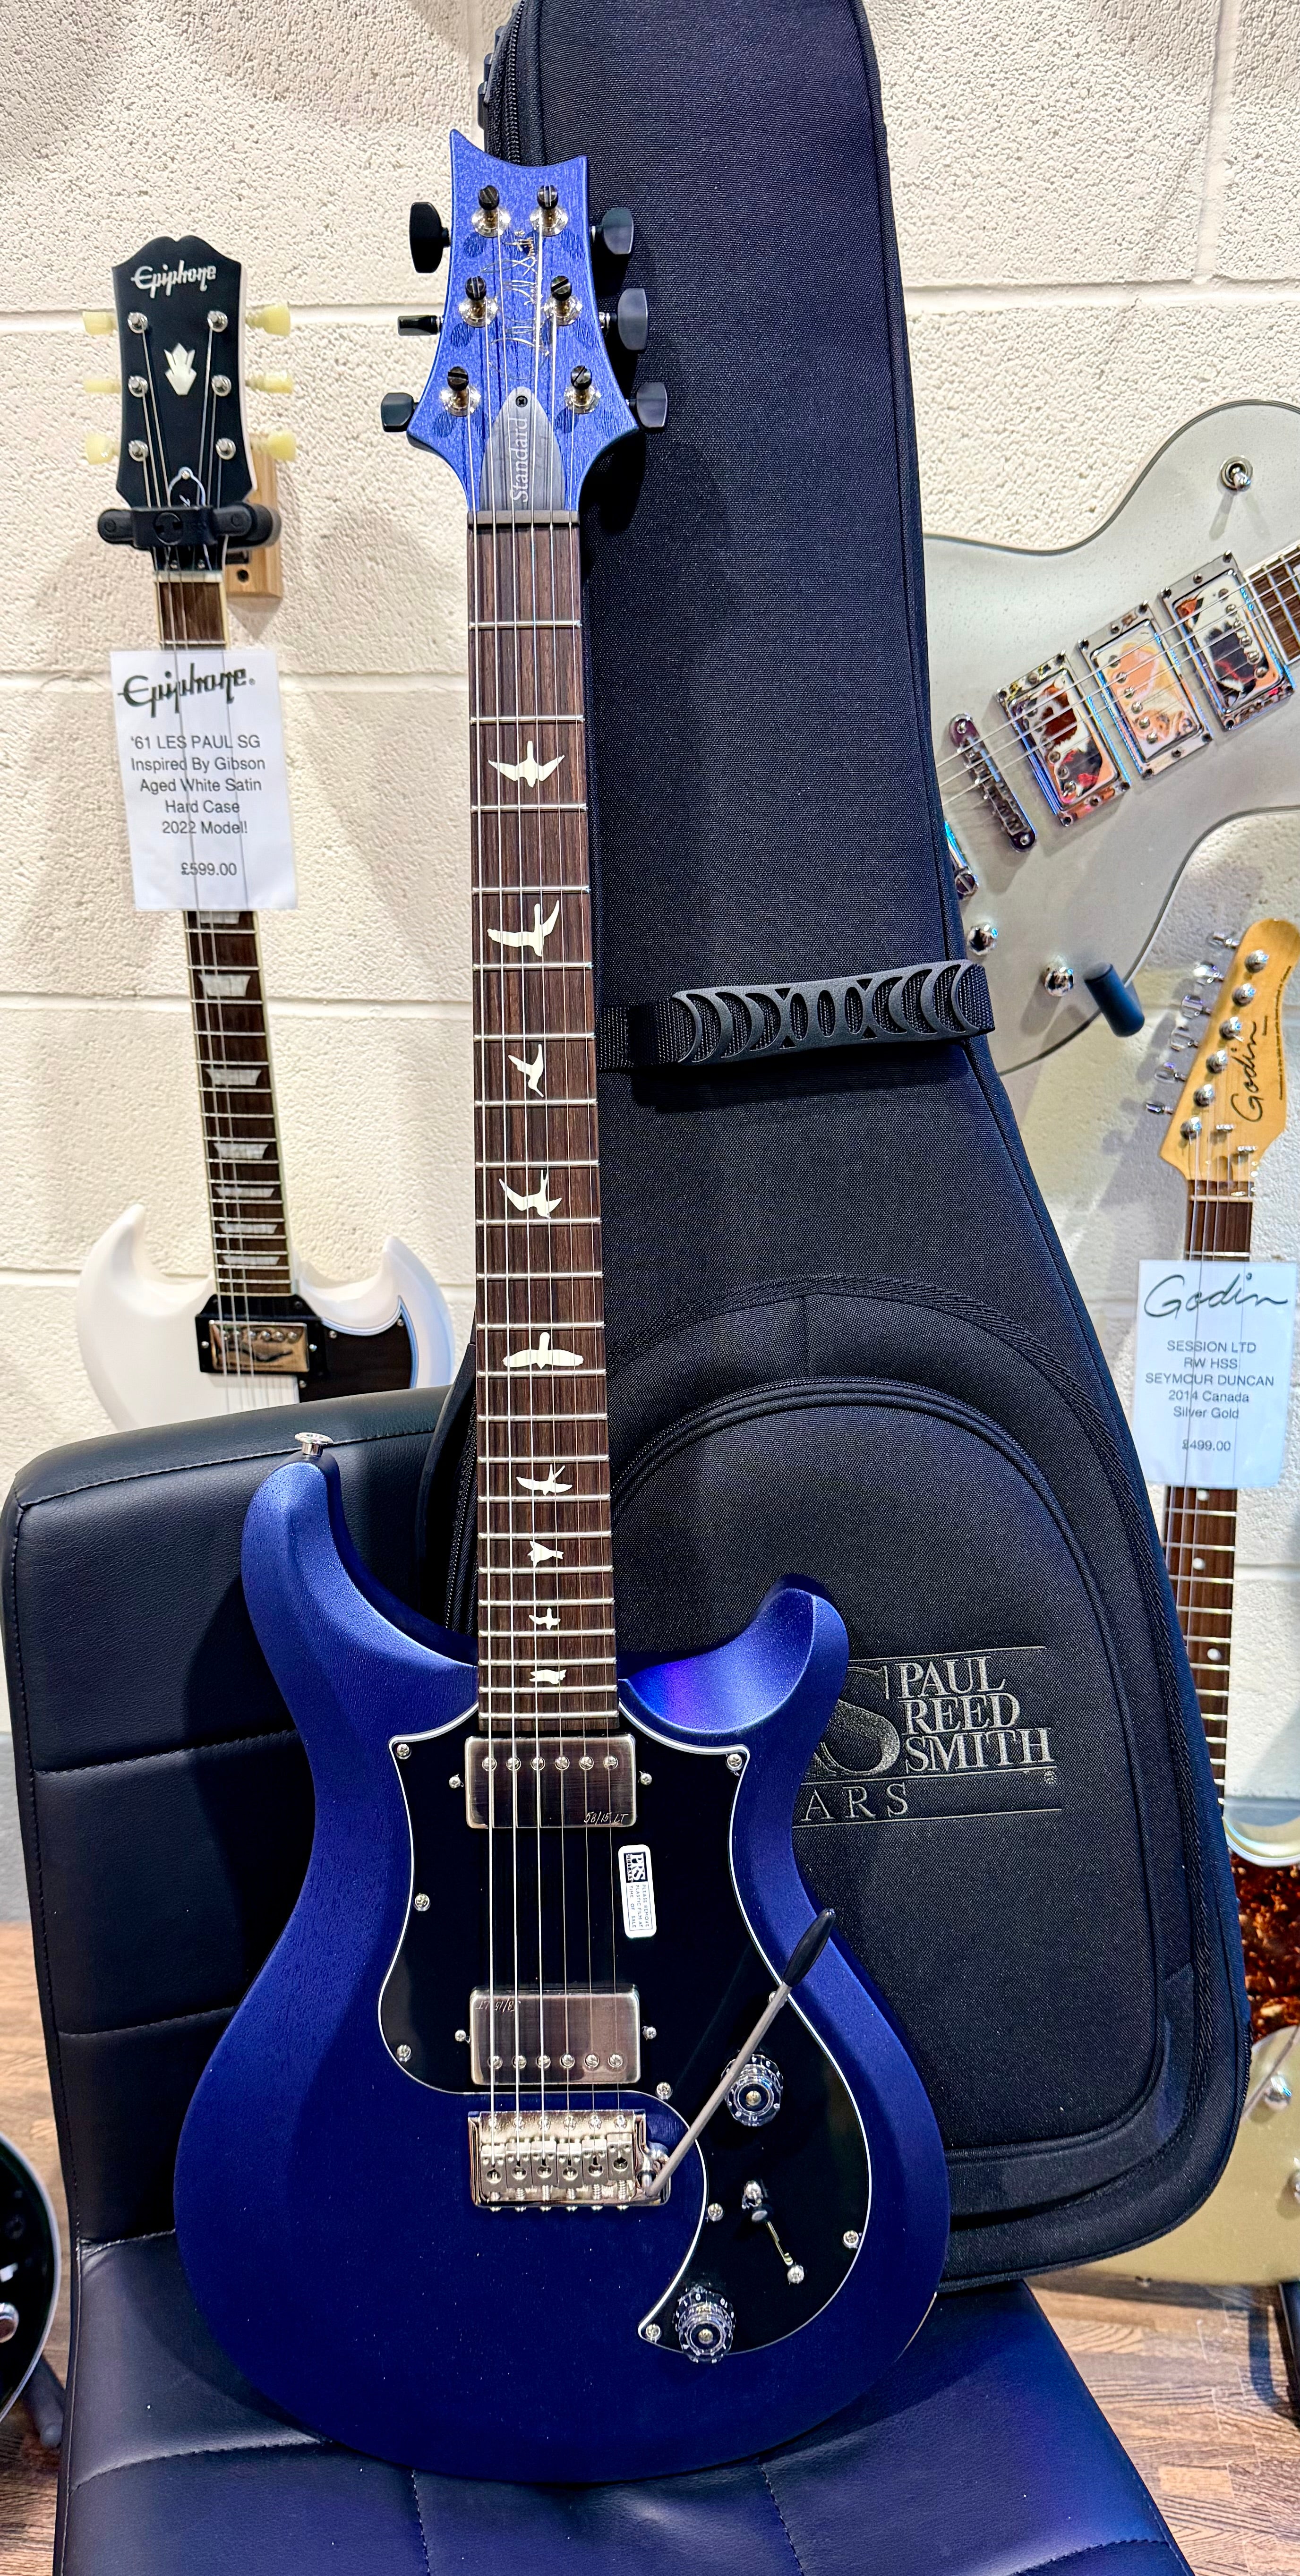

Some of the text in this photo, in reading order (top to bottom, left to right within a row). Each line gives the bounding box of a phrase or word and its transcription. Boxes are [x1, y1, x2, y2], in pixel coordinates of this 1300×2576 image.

[130, 259, 217, 299] Epiphone
[510, 418, 530, 503] Standard
[117, 663, 248, 718] Epiphone
[157, 735, 187, 749] LES
[192, 735, 232, 749] PAUL
[238, 735, 260, 748] SG
[132, 757, 265, 774] Inspired By Gibson
[141, 778, 261, 795] Aged White Satin
[166, 801, 239, 813] Hard Case
[162, 821, 247, 834] 2022 Model!
[181, 863, 237, 876] £599.00
[1231, 1022, 1263, 1123] Godin
[1144, 1272, 1288, 1319] Godin
[1167, 1340, 1257, 1354] SESSION LTD
[1184, 1357, 1238, 1369] RW HSS
[1146, 1373, 1274, 1386] SEYMOUR DUNCAN
[1168, 1390, 1249, 1403] 2014 Canada
[1173, 1407, 1239, 1419] Silver Gold
[1182, 1439, 1231, 1451] £499.00
[895, 1656, 1006, 1698] PAUL
[899, 1692, 1020, 1735] REED
[906, 1727, 1055, 1774] SMITH
[583, 1811, 629, 1825] 58/15 LT
[631, 1853, 646, 1881] PRS
